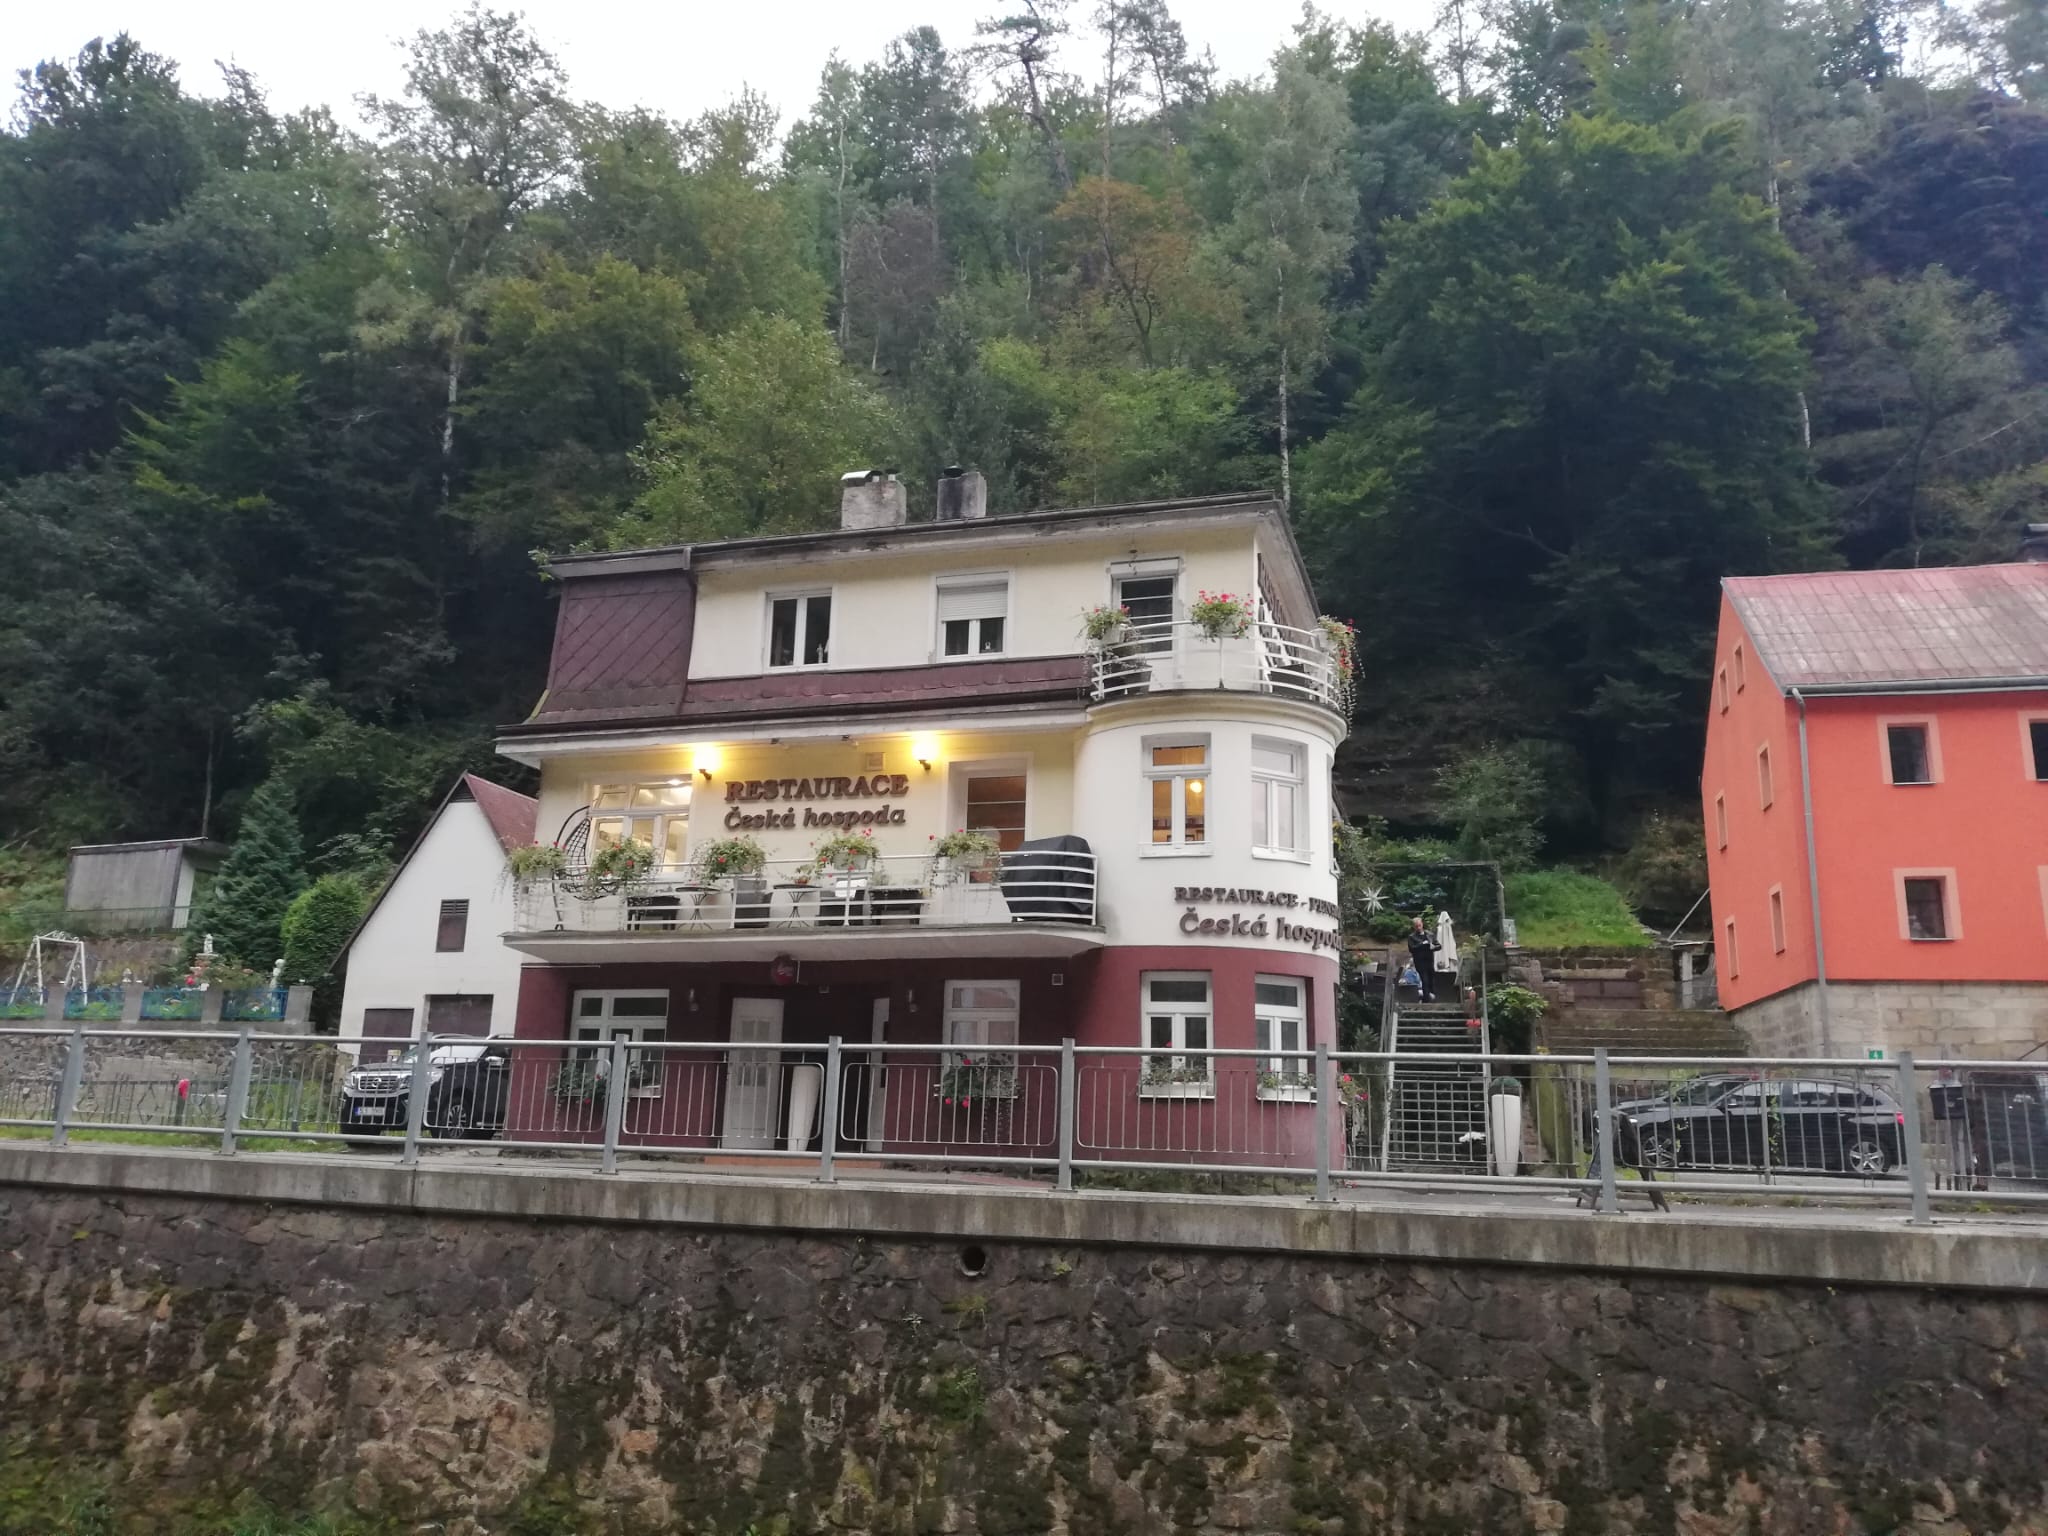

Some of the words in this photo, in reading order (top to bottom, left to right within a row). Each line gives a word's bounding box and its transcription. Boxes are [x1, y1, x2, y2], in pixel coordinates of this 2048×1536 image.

[725, 774, 909, 801] RESTAURACE
[724, 806, 796, 829] Česká
[803, 804, 906, 830] hospoda
[1174, 887, 1299, 907] RESTAURACE
[1179, 907, 1269, 936] Česká
